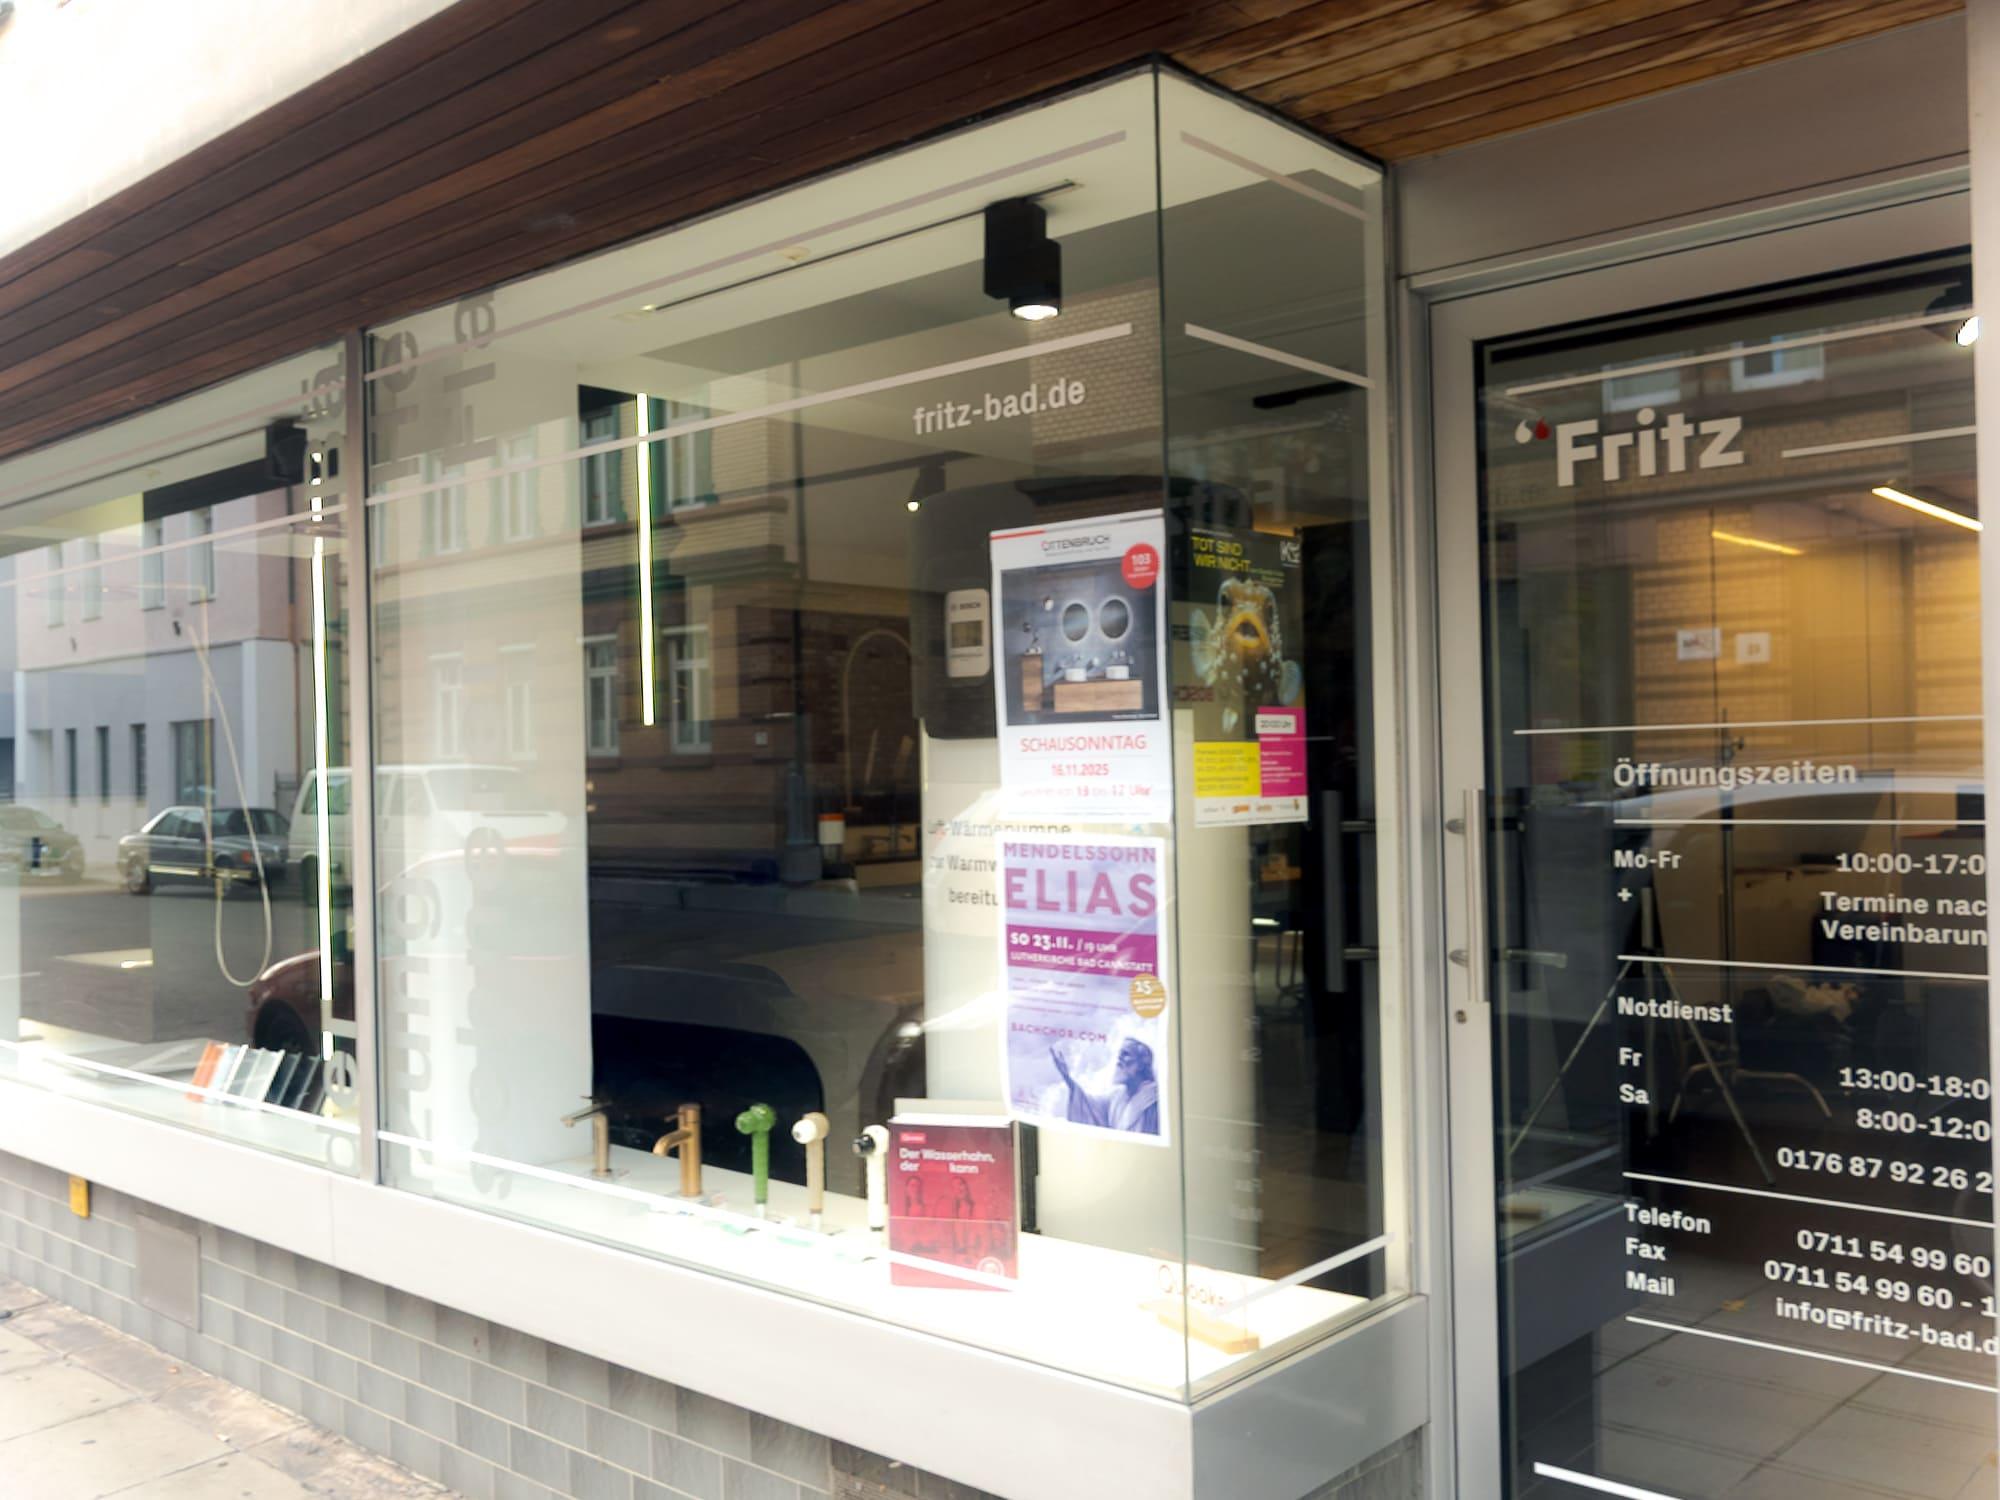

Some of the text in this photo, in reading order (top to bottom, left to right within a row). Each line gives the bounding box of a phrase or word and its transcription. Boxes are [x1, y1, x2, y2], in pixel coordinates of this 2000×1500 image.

[912, 377, 1086, 435] fritz-bad.de
[1555, 408, 1745, 488] Fritz
[1020, 734, 1148, 752] SCHAUSONNTAG
[1051, 763, 1110, 776] 16.11.2025
[1613, 758, 1857, 791] Öffnungszeiten
[1003, 842, 1157, 863] MENDELSSOHN
[1613, 849, 1682, 869] Mo-Fr
[1004, 867, 1158, 917] ELIAS
[1819, 891, 1929, 915] Termine
[1010, 931, 1031, 946] SO
[1032, 933, 1075, 951] 23.11.
[1820, 919, 1988, 946] Vereinbarun
[1617, 996, 1734, 1024] Notdienst
[1011, 1022, 1108, 1043] BACHCHOR.COM
[1619, 1047, 1643, 1068] Fr
[1619, 1084, 1650, 1105] Sa
[1776, 1147, 1844, 1174] 0176
[1849, 1156, 1883, 1179] 87
[1889, 1160, 1925, 1185] 92
[1931, 1165, 1968, 1191] 26
[1624, 1203, 1991, 1279] Telefon 0711 54 99 60
[1625, 1236, 1666, 1262] Fax
[1763, 1259, 1830, 1290] 0711
[1834, 1271, 1870, 1296] 54
[1875, 1277, 1911, 1303] 99
[1916, 1285, 1953, 1310] 60
[1625, 1270, 1676, 1297] Mail
